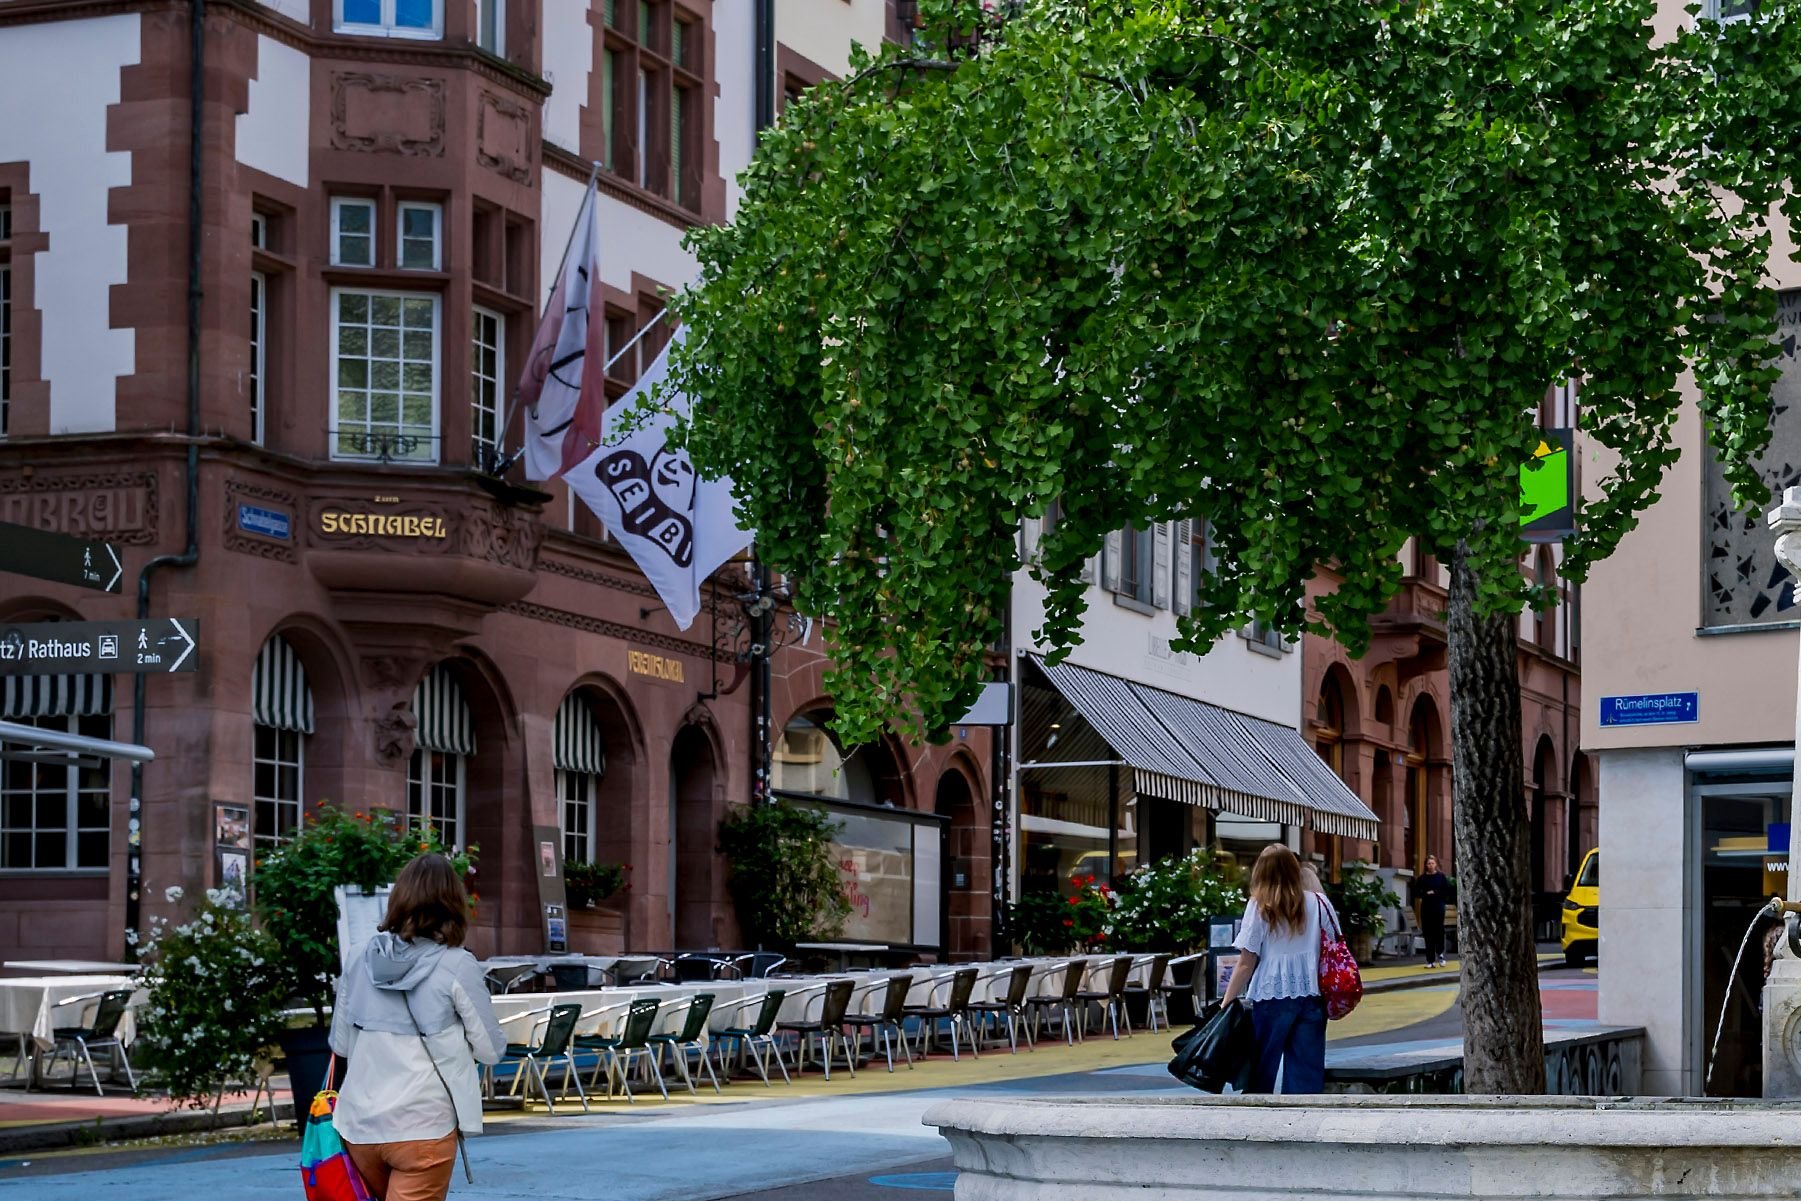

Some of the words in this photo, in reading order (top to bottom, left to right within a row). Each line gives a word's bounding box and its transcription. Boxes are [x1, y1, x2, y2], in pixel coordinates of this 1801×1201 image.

[321, 512, 446, 538] SCHNABEL
[28, 639, 91, 659] Rathaus
[136, 653, 143, 664] 2
[144, 652, 161, 664] min
[1615, 695, 1682, 711] Rümelinsplatz
